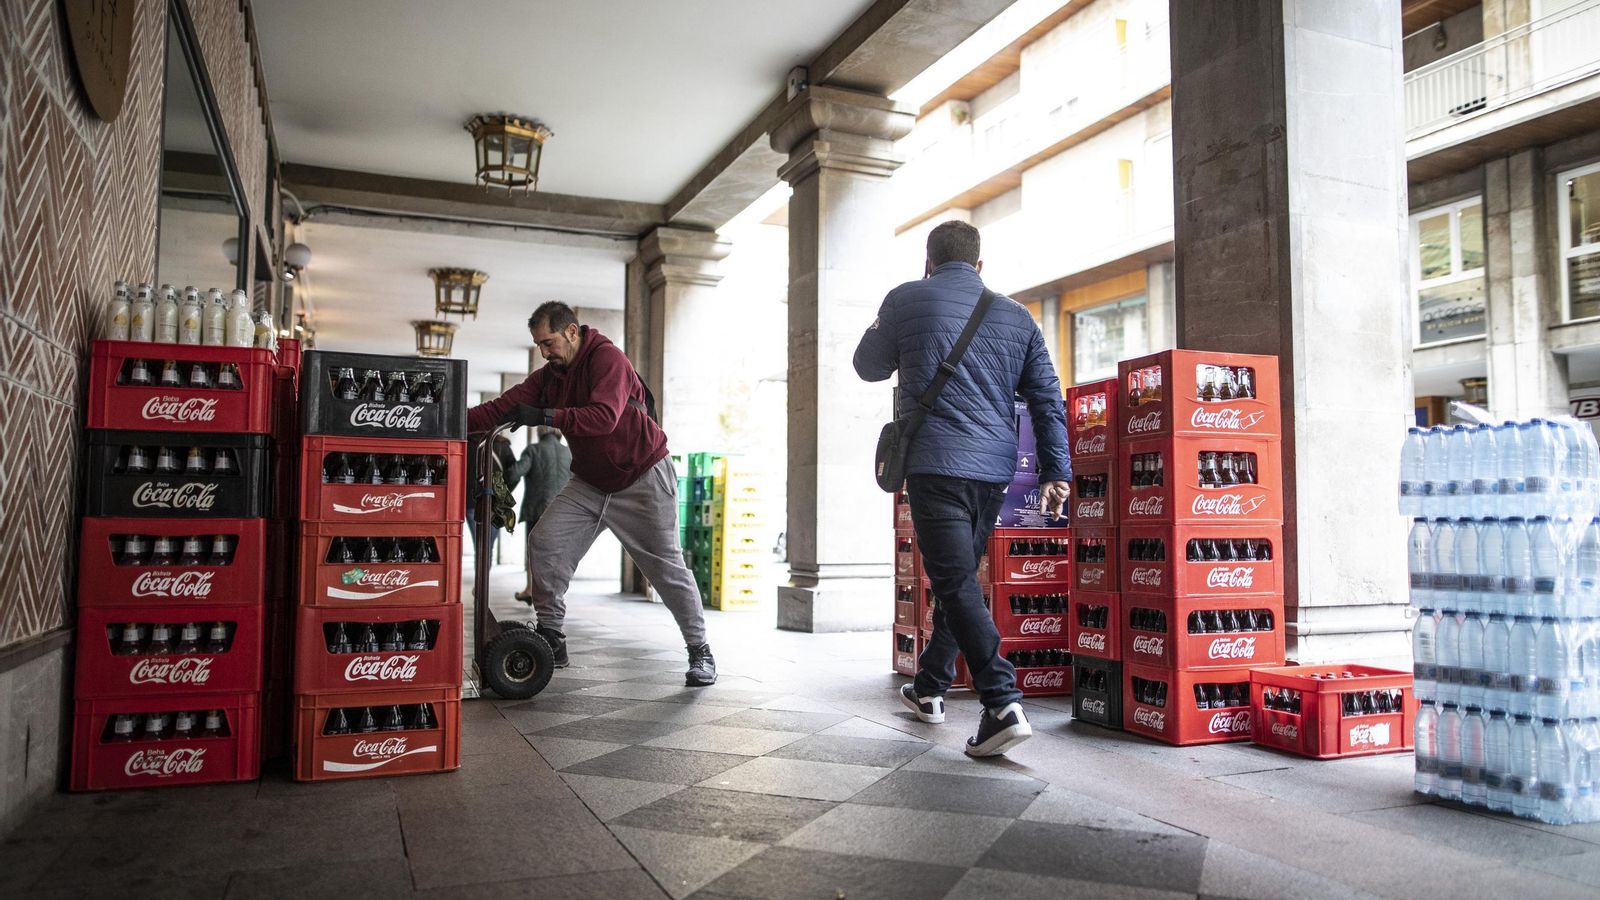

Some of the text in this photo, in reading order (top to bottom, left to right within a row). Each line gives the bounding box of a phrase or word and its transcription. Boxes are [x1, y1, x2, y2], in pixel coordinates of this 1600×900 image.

[142, 397, 219, 421] Coca-Cola
[350, 403, 424, 428] Coca-Cola
[1191, 407, 1242, 429] Coca-Cola
[1128, 411, 1162, 434] Coca-Cola
[1075, 434, 1106, 454] Coca-Cola
[132, 481, 219, 509] Coca-Cola
[361, 492, 404, 507] Coca-Cola
[1192, 494, 1243, 515] Coca-Cola
[1077, 501, 1104, 518] Coca-Cola
[1129, 496, 1164, 515] Coca-Cola
[1022, 560, 1056, 573] Coca-Cola
[1131, 567, 1162, 586] Coca-Cola
[131, 572, 215, 597] Coca-Cola
[1207, 567, 1254, 587] Coca-Cola
[1020, 617, 1062, 634] Coca-Cola
[1078, 632, 1105, 650] Coca-Cola
[1133, 635, 1164, 655] Coca-Cola
[1208, 637, 1256, 659] Coca-Cola
[130, 658, 213, 684] Coca-Cola
[344, 655, 420, 681] Coca-Cola
[1023, 671, 1064, 688] Coca-Cola
[1082, 697, 1104, 714] Coca-Cola
[1134, 707, 1165, 730] Coca-Cola
[1208, 711, 1251, 734] Coca-Col
[352, 737, 408, 757] Coca-Cola
[124, 748, 207, 776] Coca-Cola
